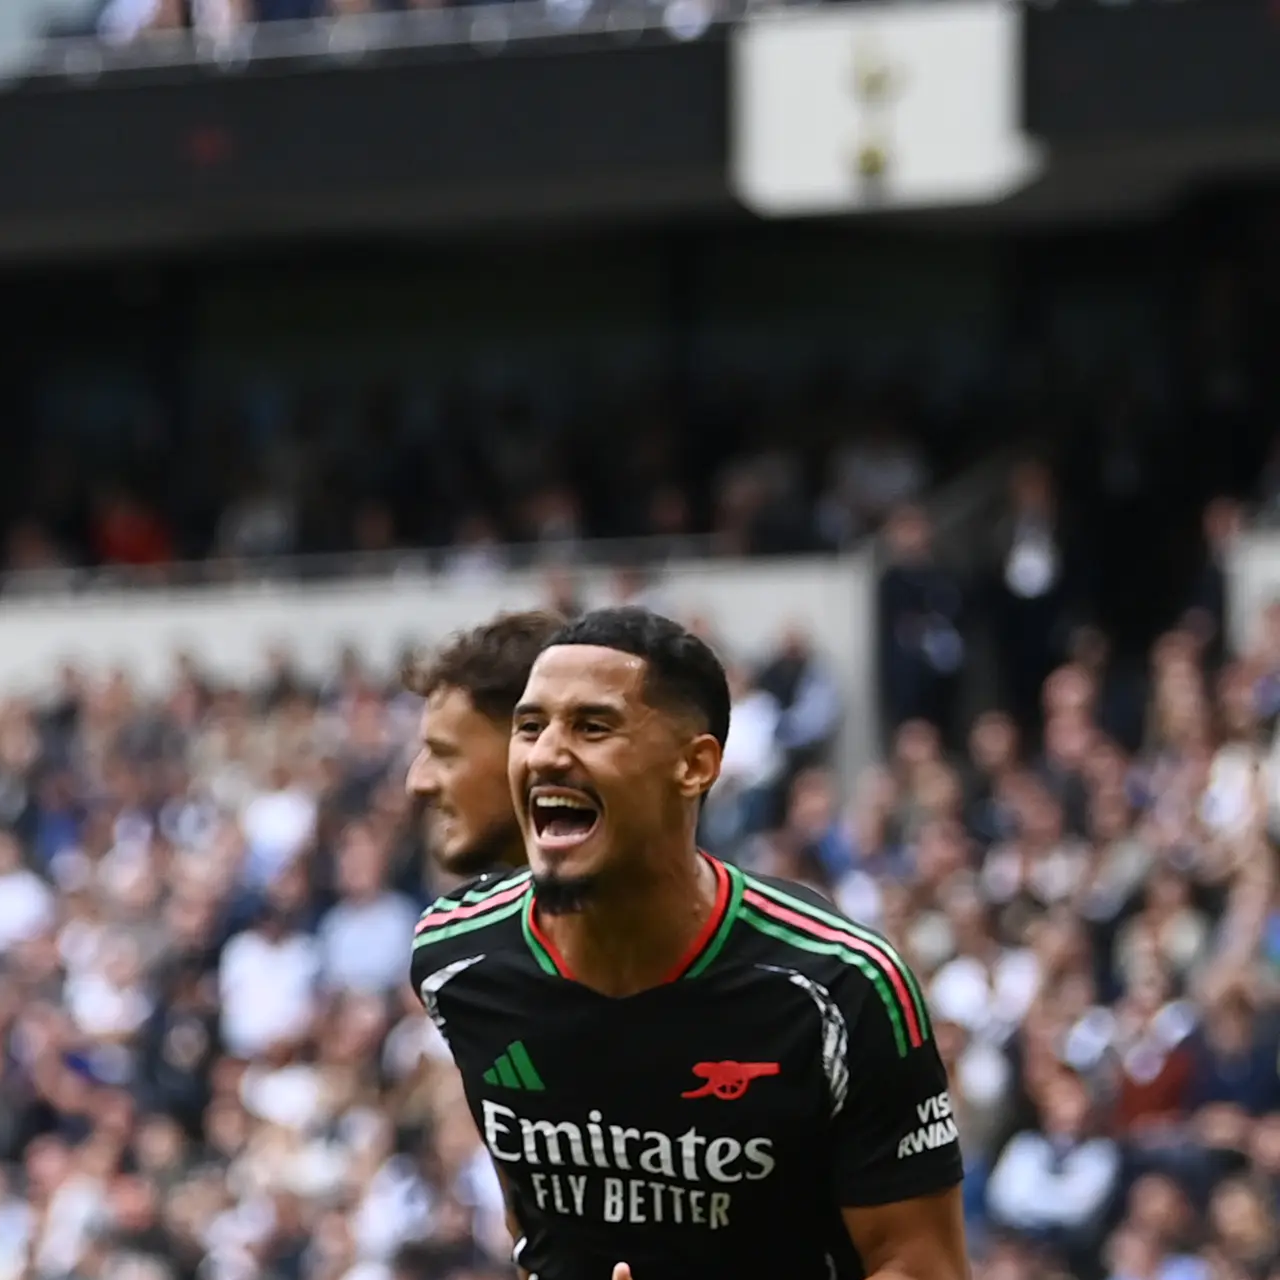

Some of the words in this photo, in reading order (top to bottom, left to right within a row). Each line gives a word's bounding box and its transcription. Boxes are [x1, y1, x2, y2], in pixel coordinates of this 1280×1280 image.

[916, 1091, 952, 1124] VIS
[481, 1099, 776, 1183] Emirates
[898, 1117, 959, 1159] RWAN
[531, 1172, 588, 1216] FLY
[603, 1177, 731, 1230] BETTER
